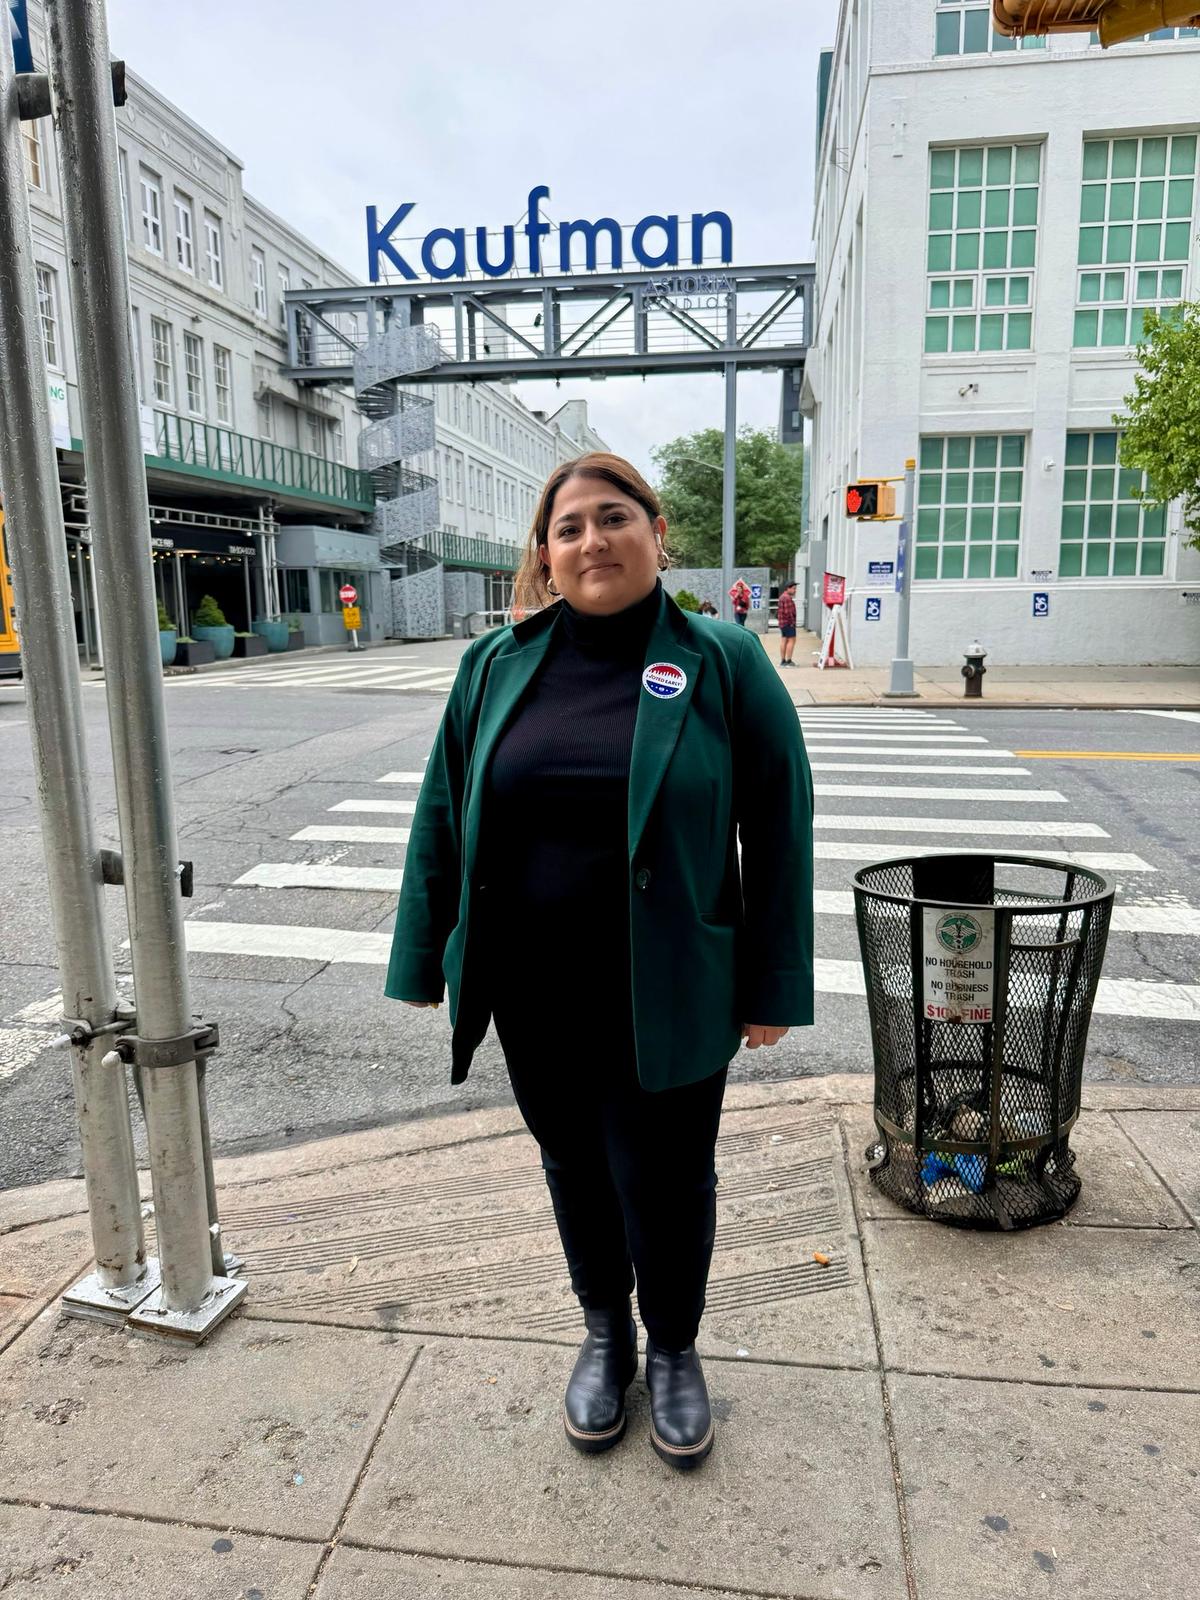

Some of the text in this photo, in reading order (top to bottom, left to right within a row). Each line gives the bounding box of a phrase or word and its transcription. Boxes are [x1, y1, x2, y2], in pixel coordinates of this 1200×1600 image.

[366, 185, 733, 283] Kaufman
[642, 274, 734, 298] ASTORIA
[925, 956, 993, 970] NO HOUSEHOLD
[945, 968, 975, 979] TRASH
[931, 980, 989, 993] NO BUSINESS
[944, 991, 975, 1001] TRASH
[961, 1008, 992, 1021] FINE
